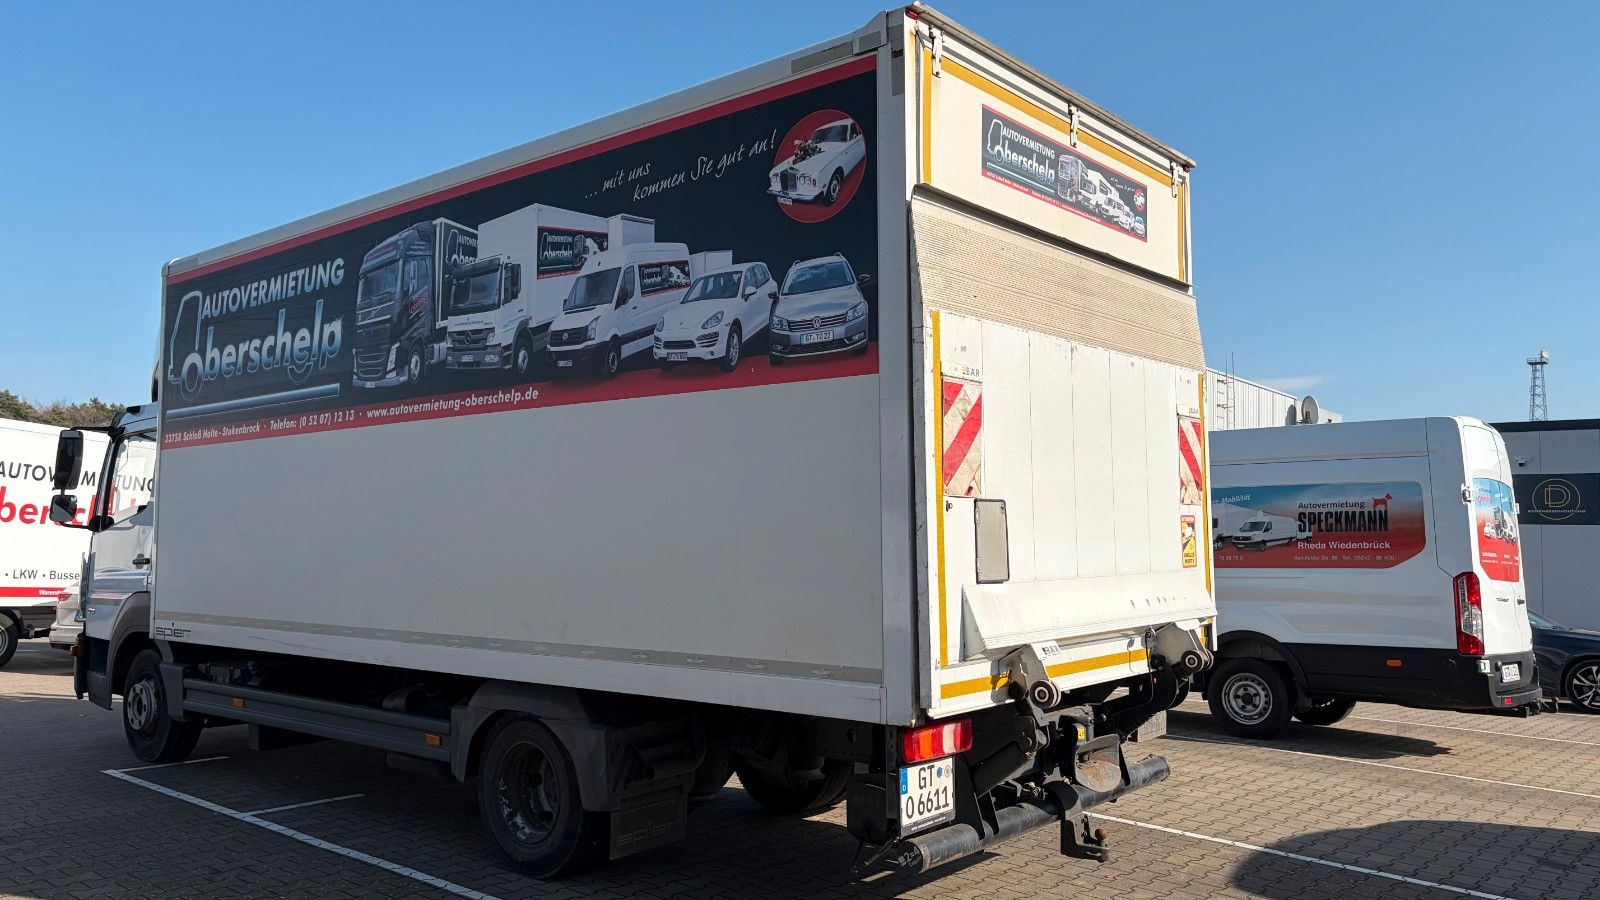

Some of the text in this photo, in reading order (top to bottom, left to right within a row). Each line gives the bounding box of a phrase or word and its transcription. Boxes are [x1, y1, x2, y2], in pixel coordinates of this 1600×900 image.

[1002, 126, 1056, 160] AUTOVERMIETUNG
[602, 171, 623, 193] mit
[628, 162, 651, 183] uns
[632, 170, 686, 203] kommen
[690, 155, 714, 182] Sie
[714, 144, 745, 178] gut
[201, 257, 345, 321] AUTOVERMIETUNG
[164, 432, 182, 443] 33758
[222, 420, 260, 436] Stukenbrock
[270, 417, 297, 430] Telefon:
[308, 415, 318, 426] 52
[319, 412, 332, 426] 07)
[333, 411, 343, 423] 12
[345, 409, 355, 421] 13
[366, 386, 539, 419] www.autovermietung-oberschelp.de
[1297, 500, 1366, 510] Autovermietung
[1297, 510, 1389, 533] SPECKMANN
[1297, 540, 1391, 550] Rheda Wiedenbrück
[12, 568, 80, 581] LKW Busse
[918, 763, 935, 791] GT
[917, 785, 950, 817] 6611
